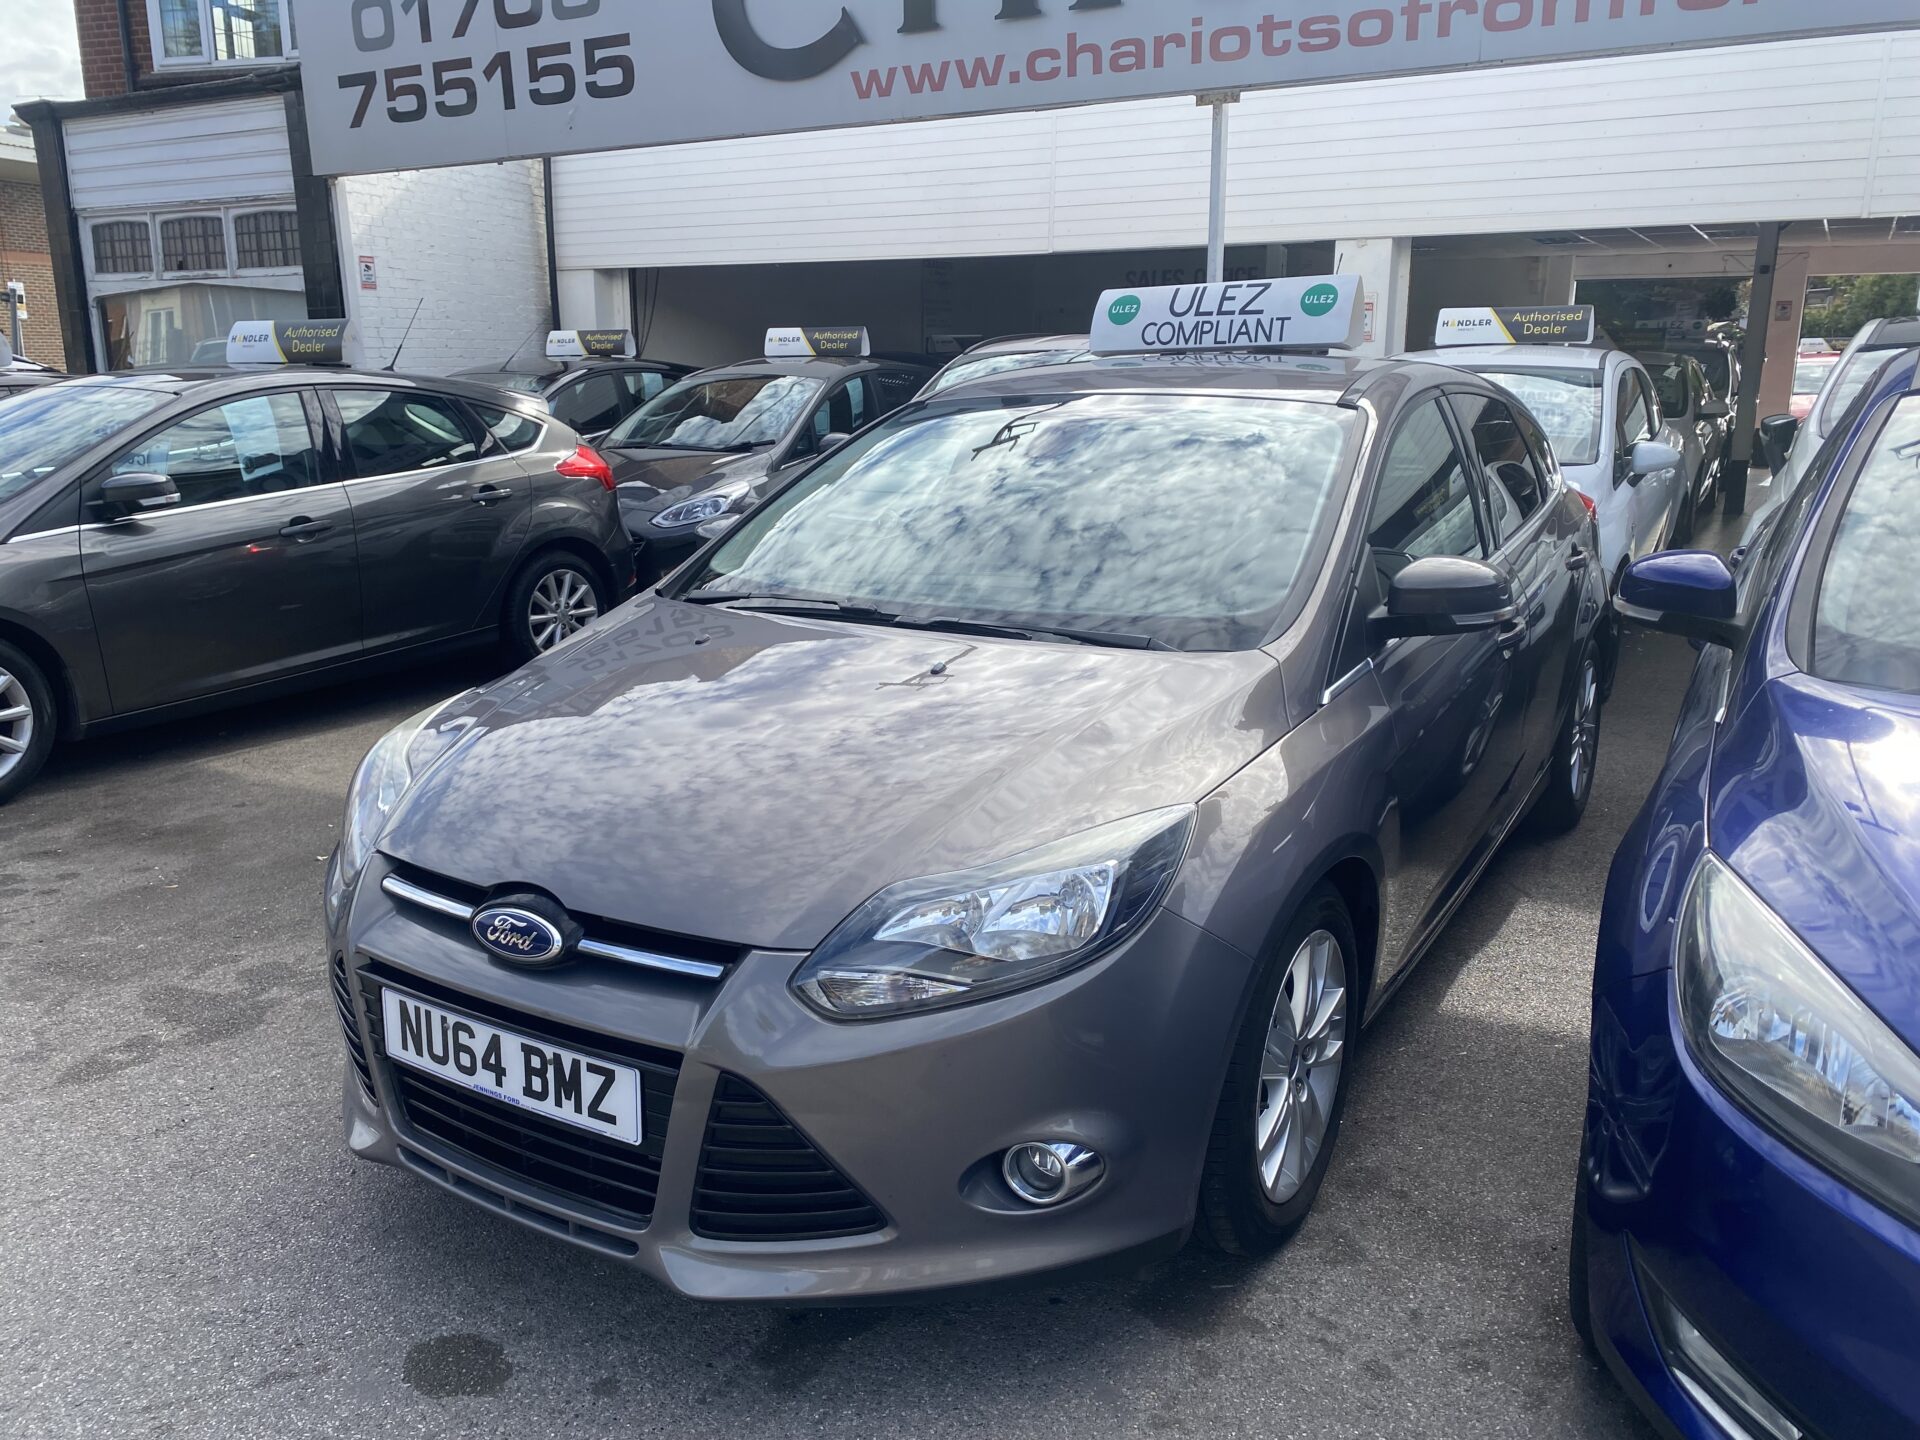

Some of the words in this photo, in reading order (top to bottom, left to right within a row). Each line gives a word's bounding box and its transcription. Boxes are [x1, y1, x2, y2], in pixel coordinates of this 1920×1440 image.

[338, 32, 636, 129] 755155
[1168, 282, 1273, 318] ULEZ
[1304, 294, 1335, 304] ULEZ
[1111, 304, 1138, 314] ULEZ
[1511, 310, 1584, 323] Authorised
[283, 324, 341, 338] Authorised
[813, 330, 859, 340] Authorised
[1141, 317, 1292, 346] COMPLIANT
[1523, 323, 1568, 335] Dealer
[585, 333, 623, 341] Authorised
[292, 340, 326, 353] Dealer
[591, 341, 615, 350] Dealer
[820, 340, 849, 349] Dealer
[486, 915, 538, 952] Ford
[398, 998, 507, 1088] NU64
[520, 1042, 617, 1126] BMZ
[472, 1083, 503, 1099] JENNINGS
[503, 1094, 520, 1105] FORD
